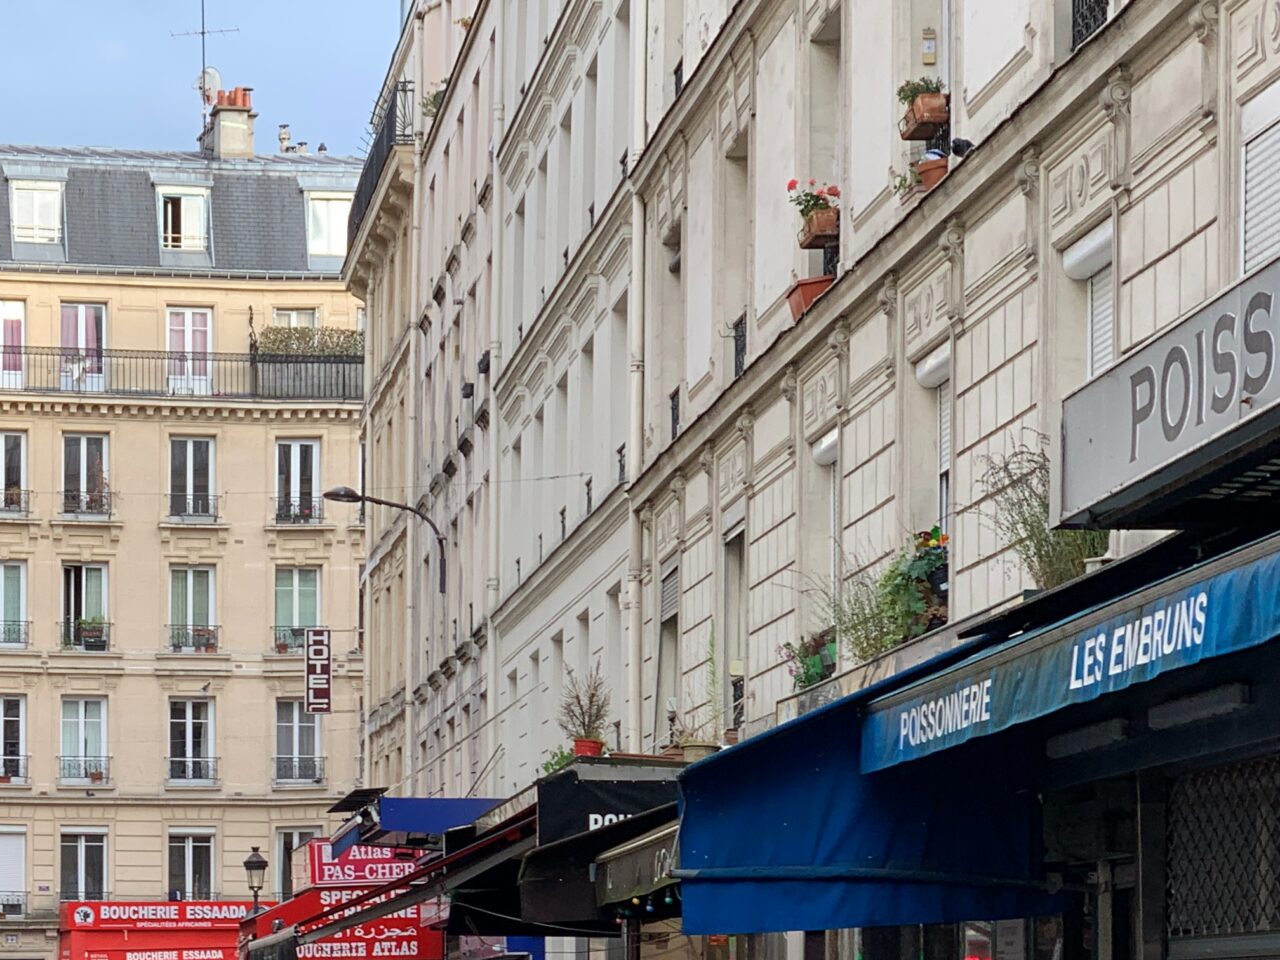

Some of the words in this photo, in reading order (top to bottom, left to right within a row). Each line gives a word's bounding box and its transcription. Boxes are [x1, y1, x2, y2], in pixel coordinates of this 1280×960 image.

[1130, 291, 1276, 463] POISS
[1069, 633, 1105, 690] LES
[1108, 592, 1209, 676] EMBRUNS
[308, 631, 329, 703] HOTEL
[898, 679, 992, 750] POISSONNERIE
[348, 845, 391, 860] Atlas
[100, 905, 178, 919] BOUCHERIE
[186, 905, 247, 919] ESSAADA
[183, 950, 224, 960] ESSAADA
[296, 942, 367, 957] OUCHERIE
[372, 941, 418, 956] ATLAS
